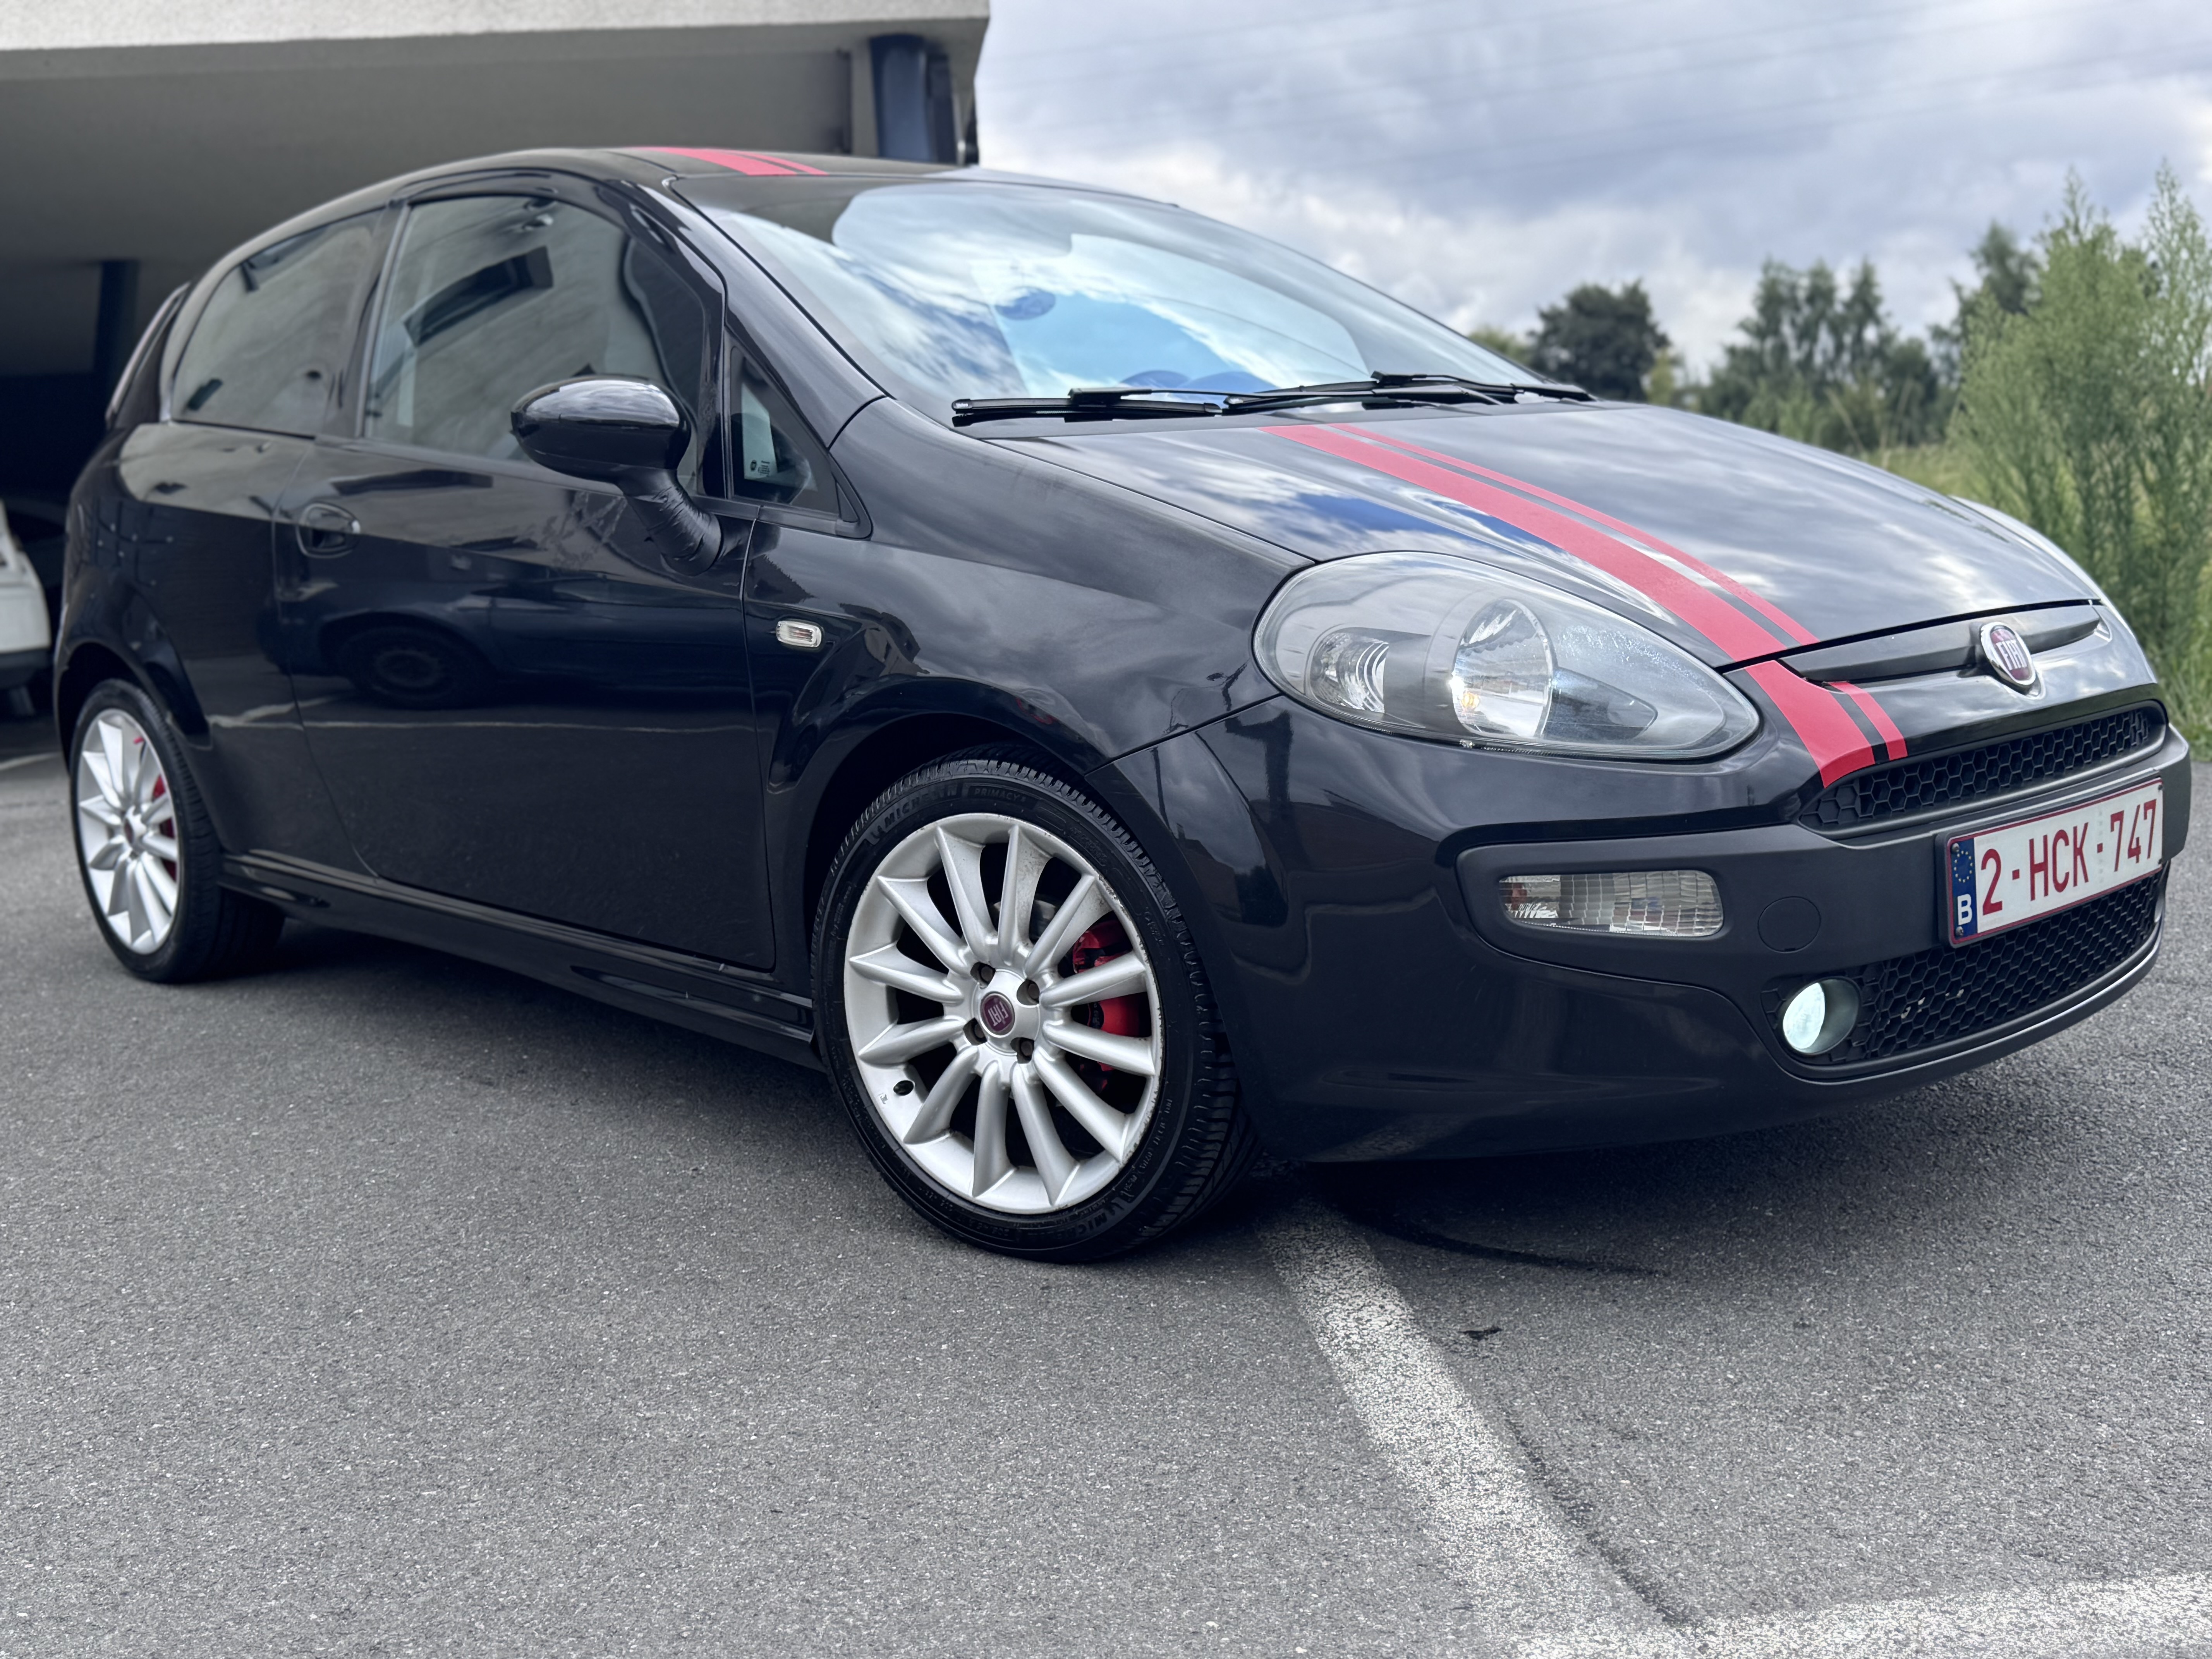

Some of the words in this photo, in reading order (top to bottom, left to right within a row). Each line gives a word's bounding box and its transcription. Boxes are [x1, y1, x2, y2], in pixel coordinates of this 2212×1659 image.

[1995, 639, 2027, 671] FIAT
[1957, 893, 1973, 926] B
[988, 1001, 1009, 1026] FIAT
